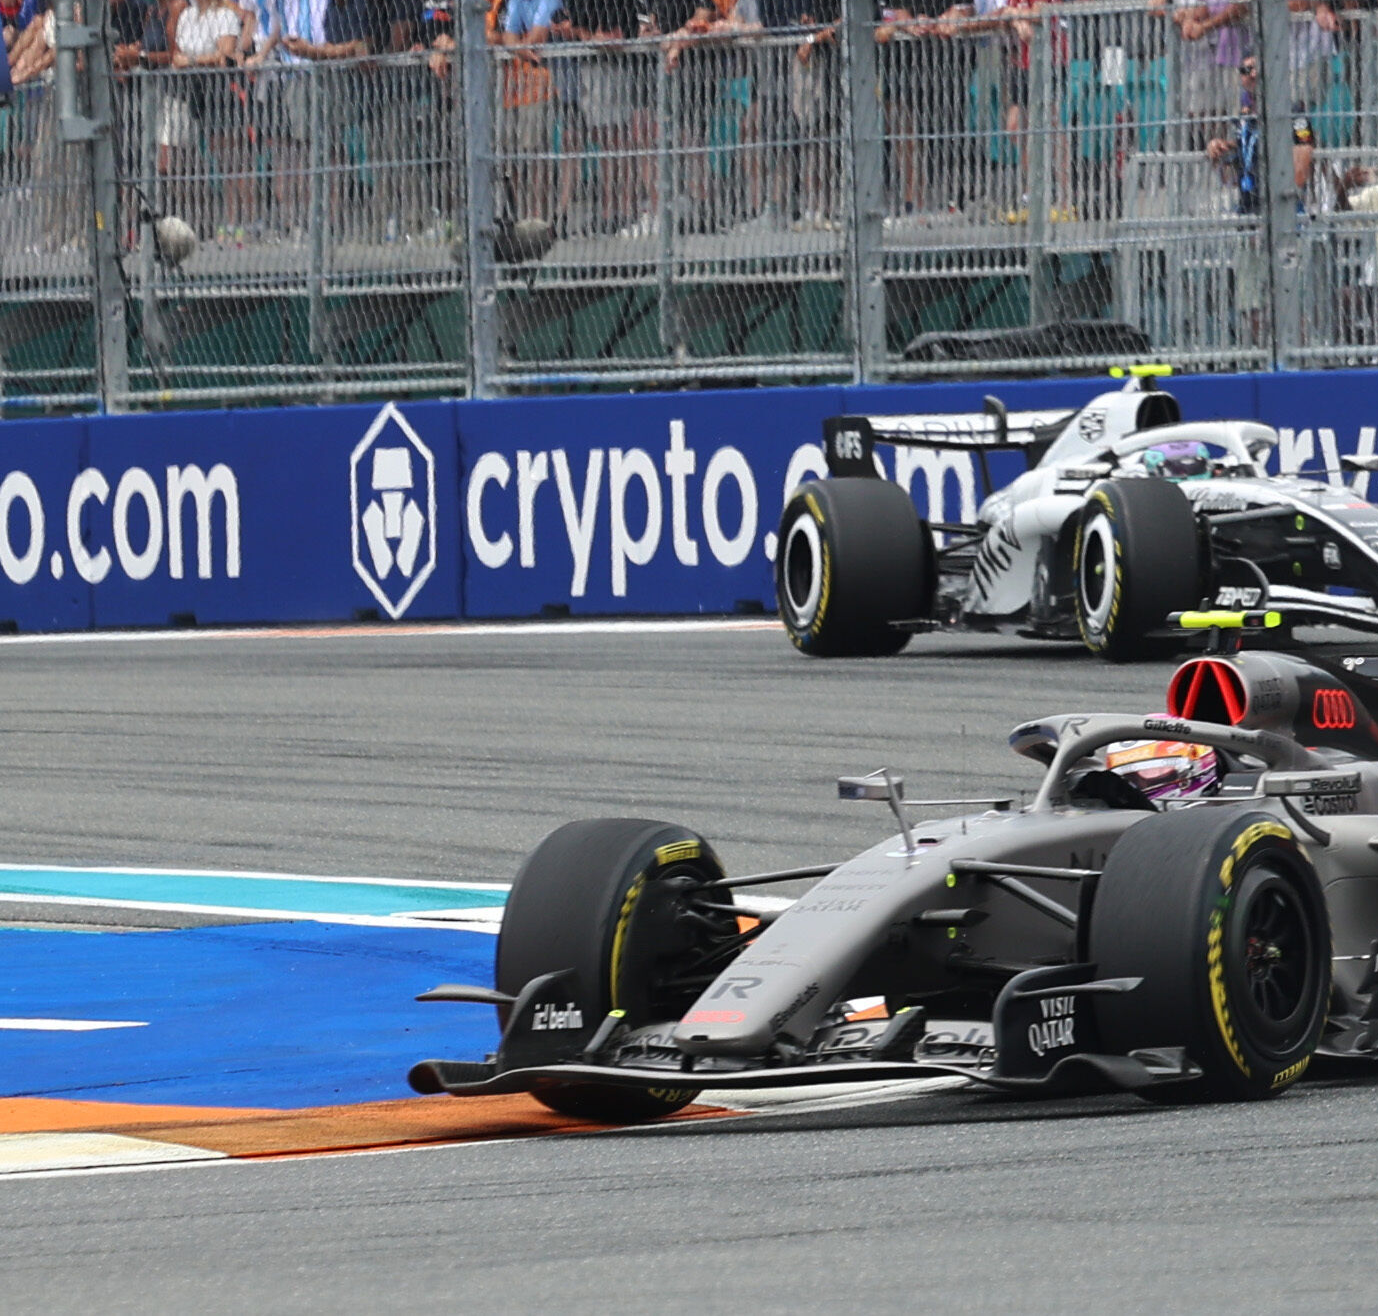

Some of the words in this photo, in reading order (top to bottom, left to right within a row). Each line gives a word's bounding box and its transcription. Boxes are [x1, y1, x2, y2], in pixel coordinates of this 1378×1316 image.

[1143, 718, 1192, 735] Gillette
[549, 1001, 583, 1030] berlin
[1027, 1017, 1075, 1057] QATAR
